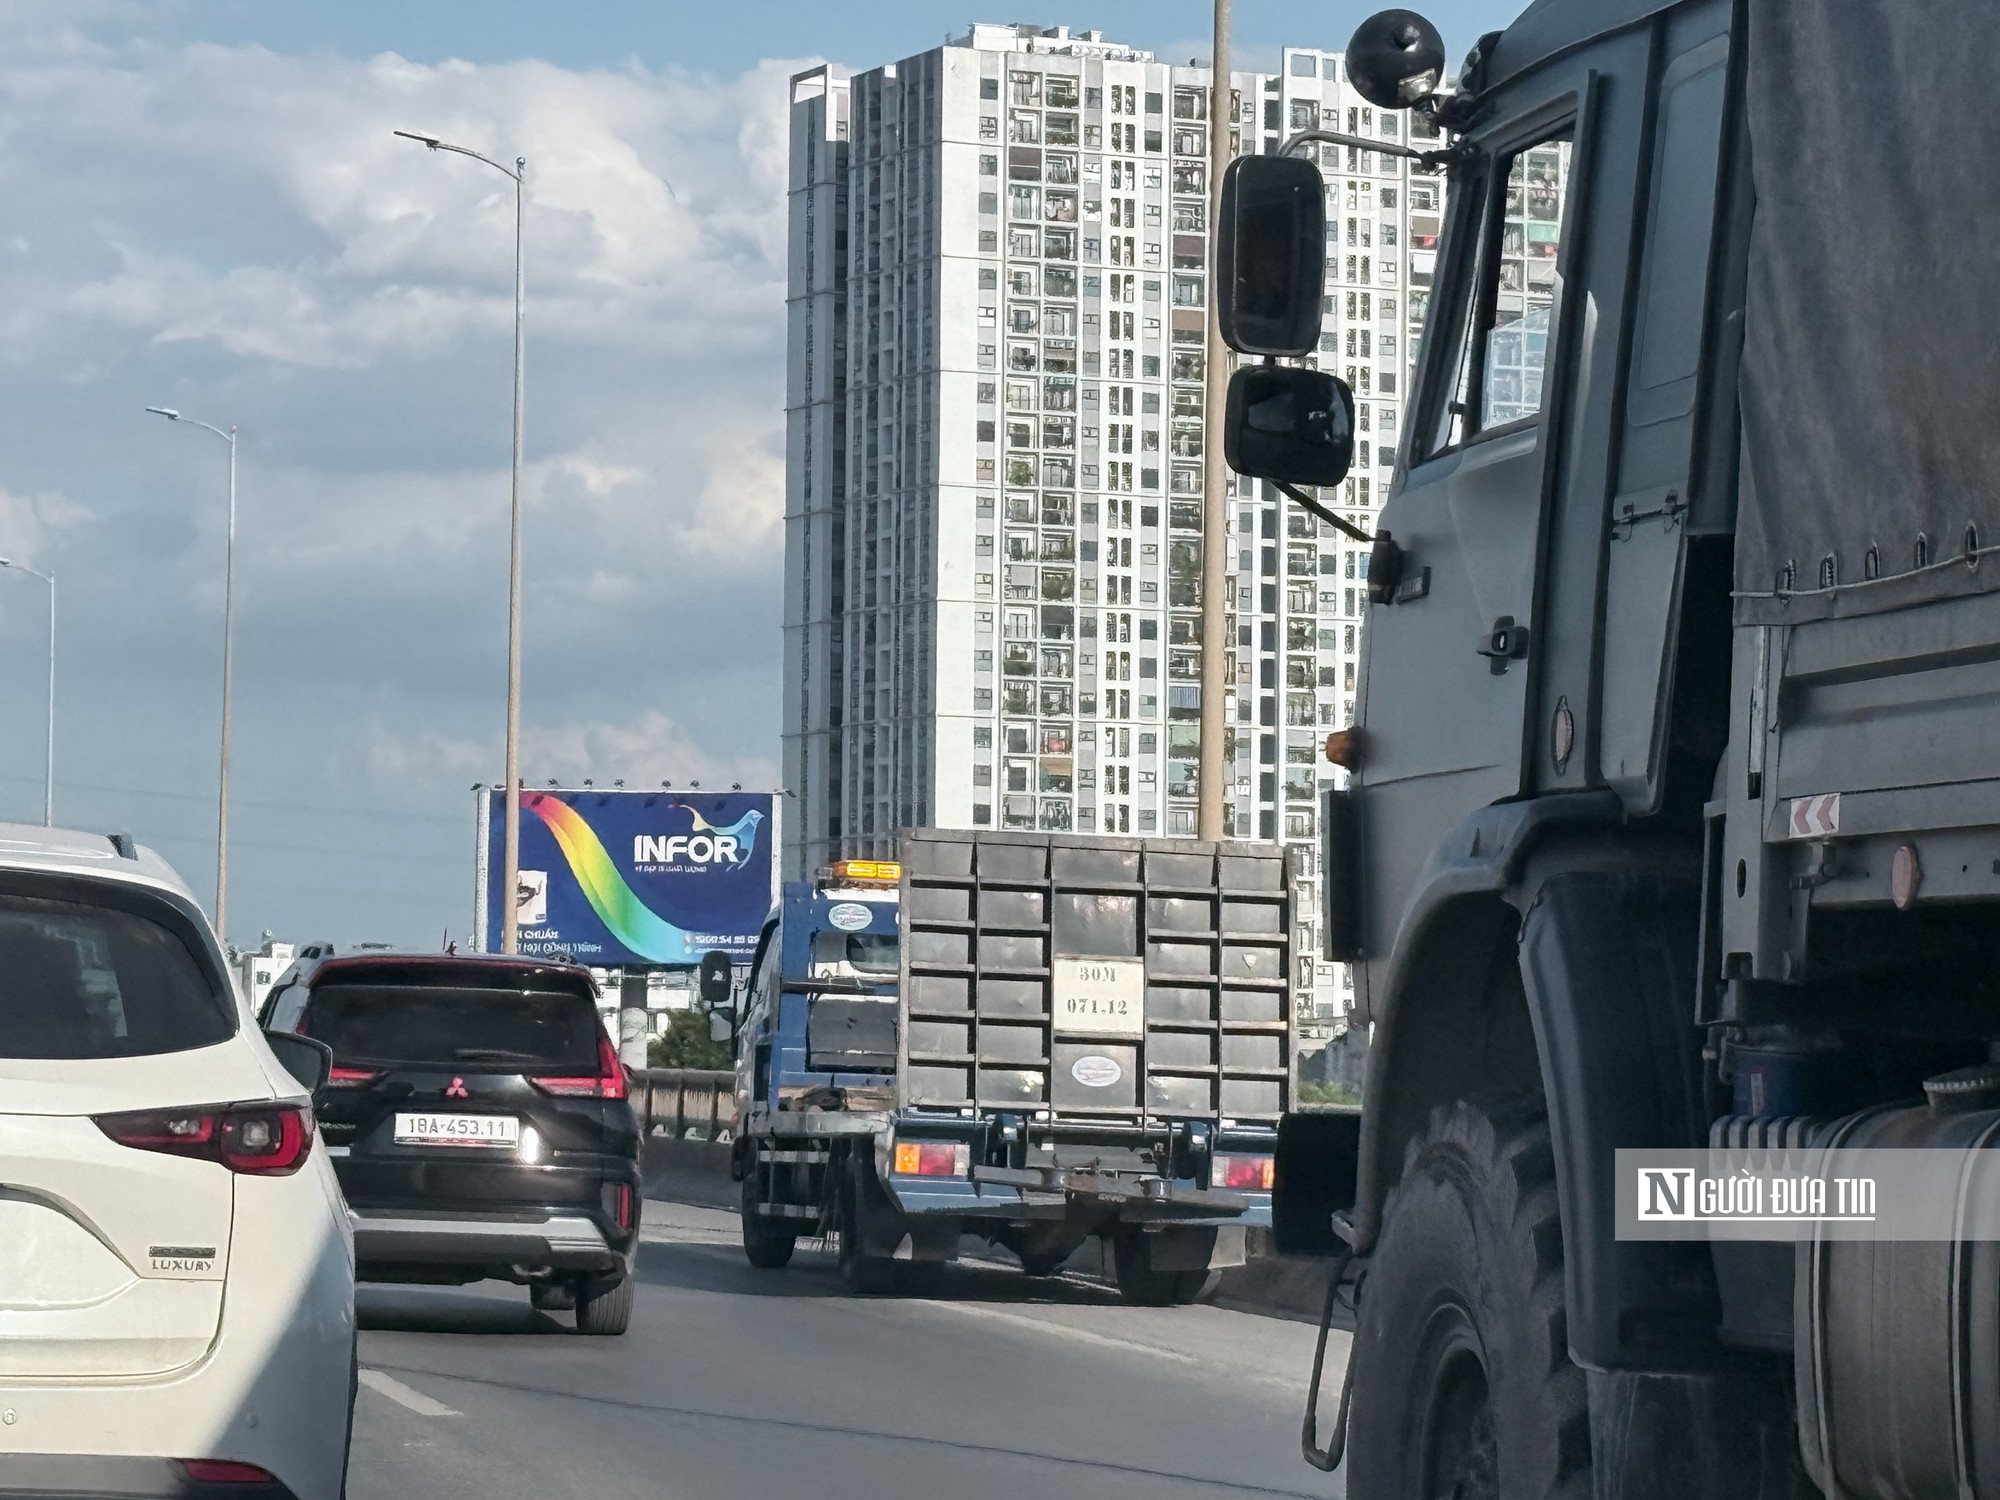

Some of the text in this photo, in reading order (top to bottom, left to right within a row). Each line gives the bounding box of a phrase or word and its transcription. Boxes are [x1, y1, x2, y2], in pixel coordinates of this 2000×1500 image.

[634, 835, 739, 863] INFOR
[1079, 966, 1116, 982] 30M
[1066, 998, 1128, 1015] 071.12
[408, 1117, 505, 1137] 18A-453.11
[152, 1259, 214, 1271] LUXURY
